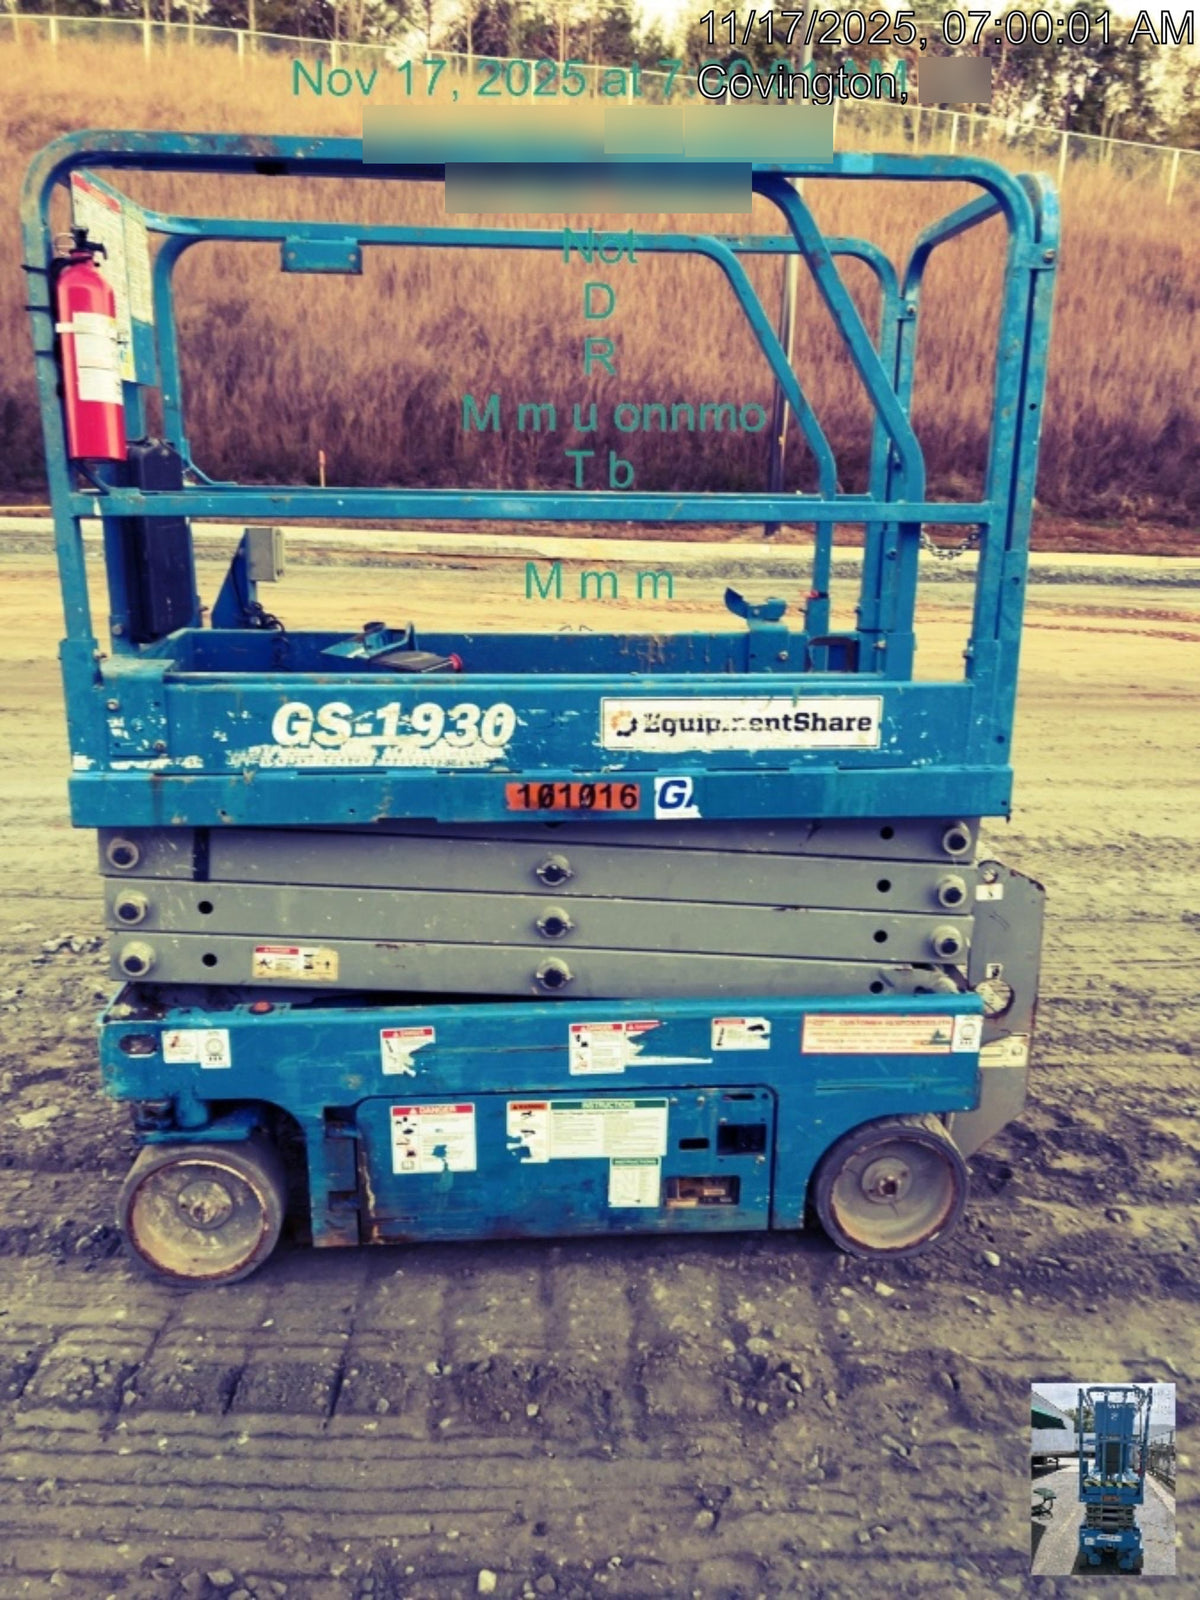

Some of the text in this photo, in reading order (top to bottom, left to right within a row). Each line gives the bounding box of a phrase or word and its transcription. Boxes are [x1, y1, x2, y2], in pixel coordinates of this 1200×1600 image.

[271, 701, 517, 748] GS-1930
[643, 712, 873, 737] EquipentShare
[516, 783, 639, 809] 101016
[657, 779, 694, 810] G
